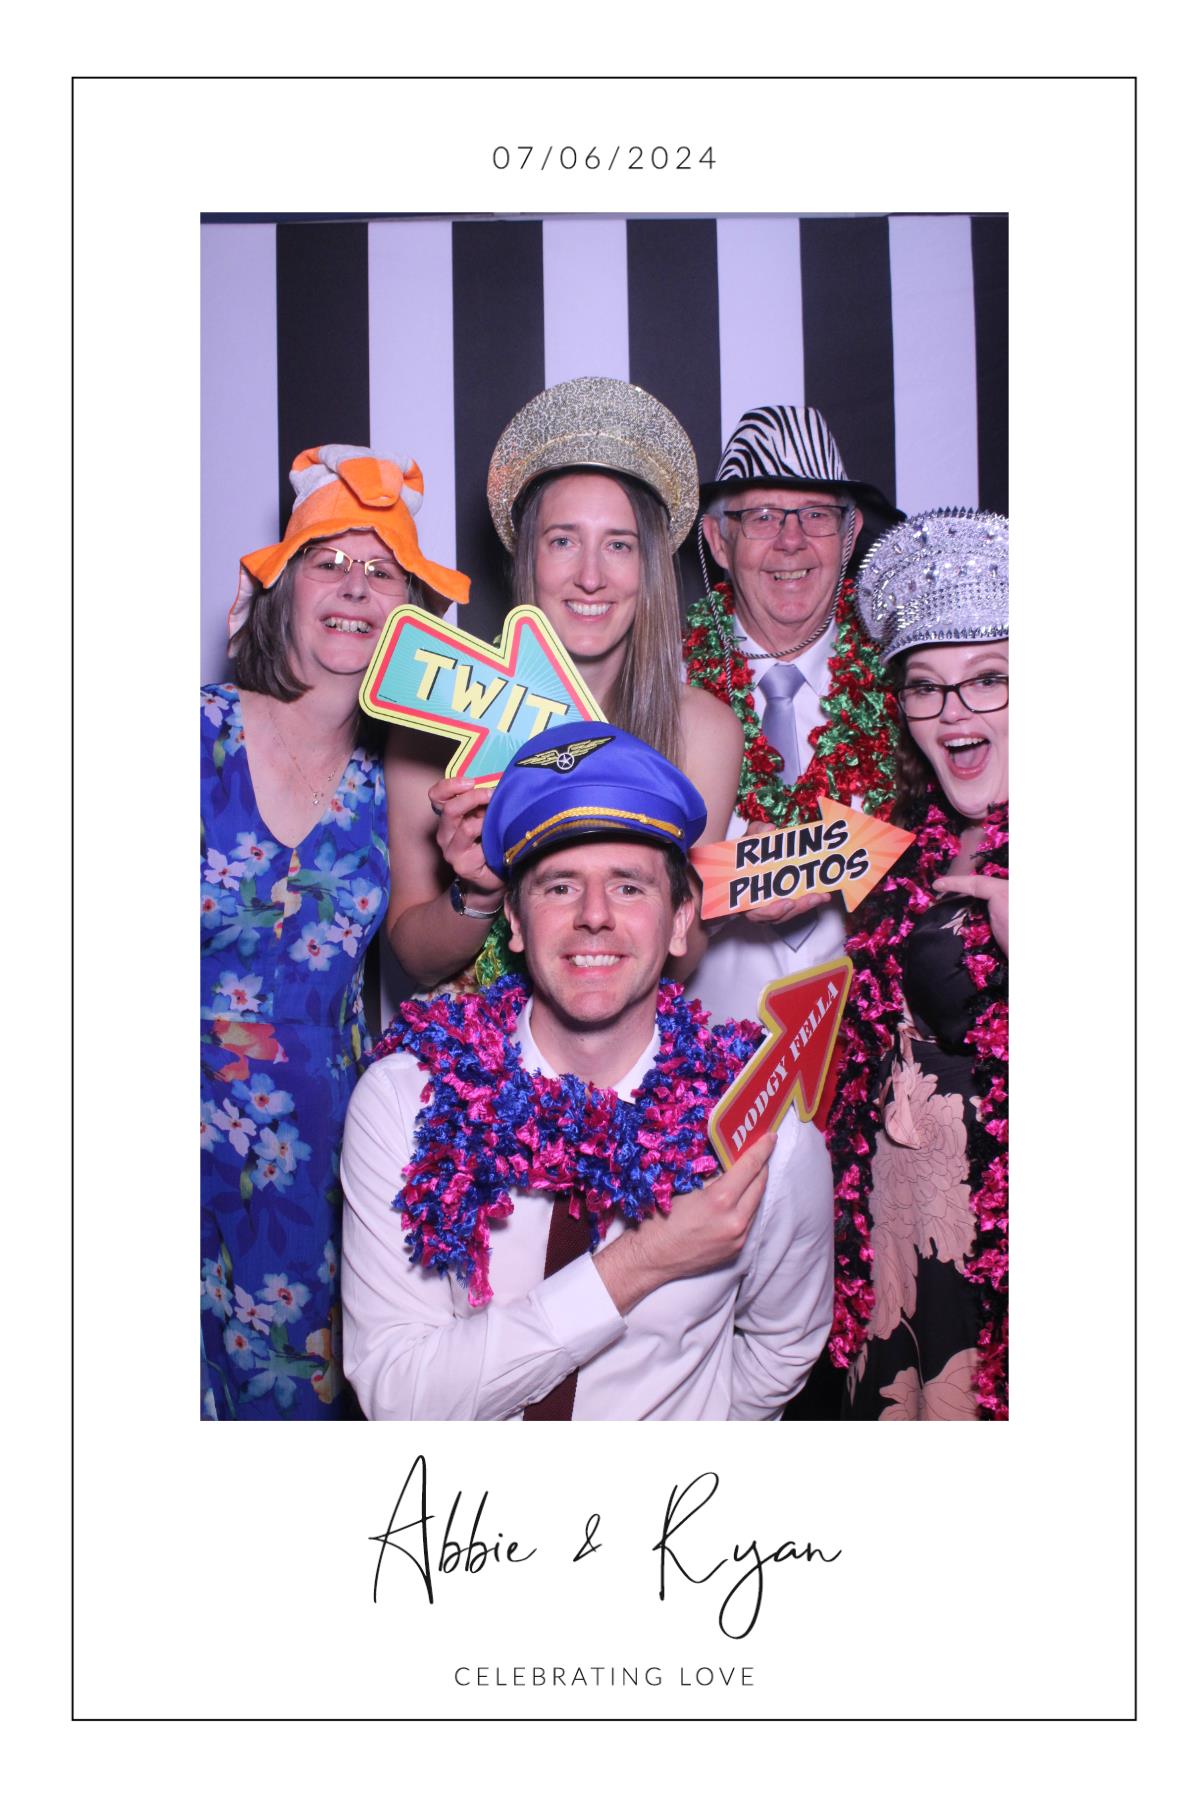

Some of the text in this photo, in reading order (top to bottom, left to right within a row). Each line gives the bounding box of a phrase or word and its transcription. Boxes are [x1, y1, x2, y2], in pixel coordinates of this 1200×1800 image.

[414, 648, 570, 739] TWIT
[729, 848, 870, 909] PHOTOS
[735, 819, 849, 870] RUINS
[731, 981, 839, 1152] DODGY FELLA
